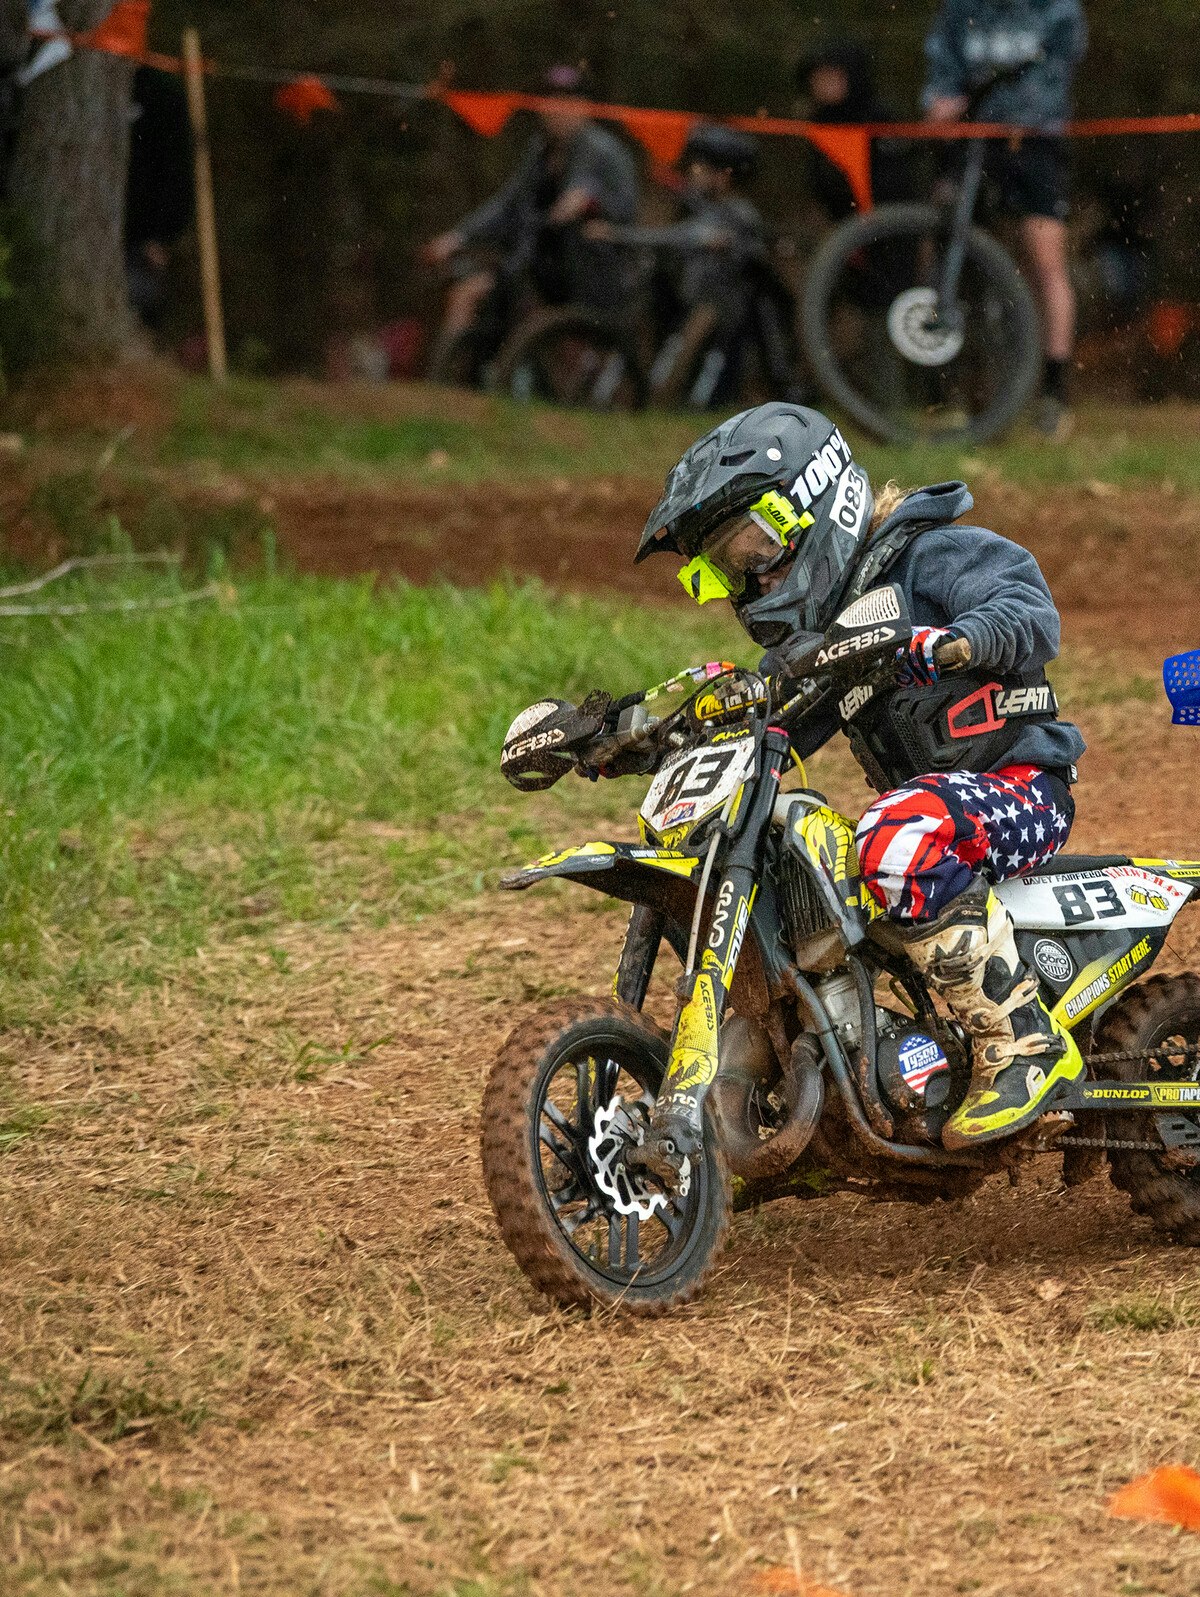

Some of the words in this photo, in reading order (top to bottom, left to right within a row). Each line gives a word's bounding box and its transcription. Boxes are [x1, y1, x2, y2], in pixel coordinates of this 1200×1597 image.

[789, 428, 852, 509] 100%
[839, 469, 863, 528] 083
[1022, 875, 1053, 886] DAVEY
[1056, 870, 1103, 882] FAIRFIELD
[1052, 879, 1127, 927] 83
[1065, 973, 1111, 1019] CHAMPIONS
[1108, 953, 1133, 983] START
[1092, 1088, 1150, 1099] DUNLOP
